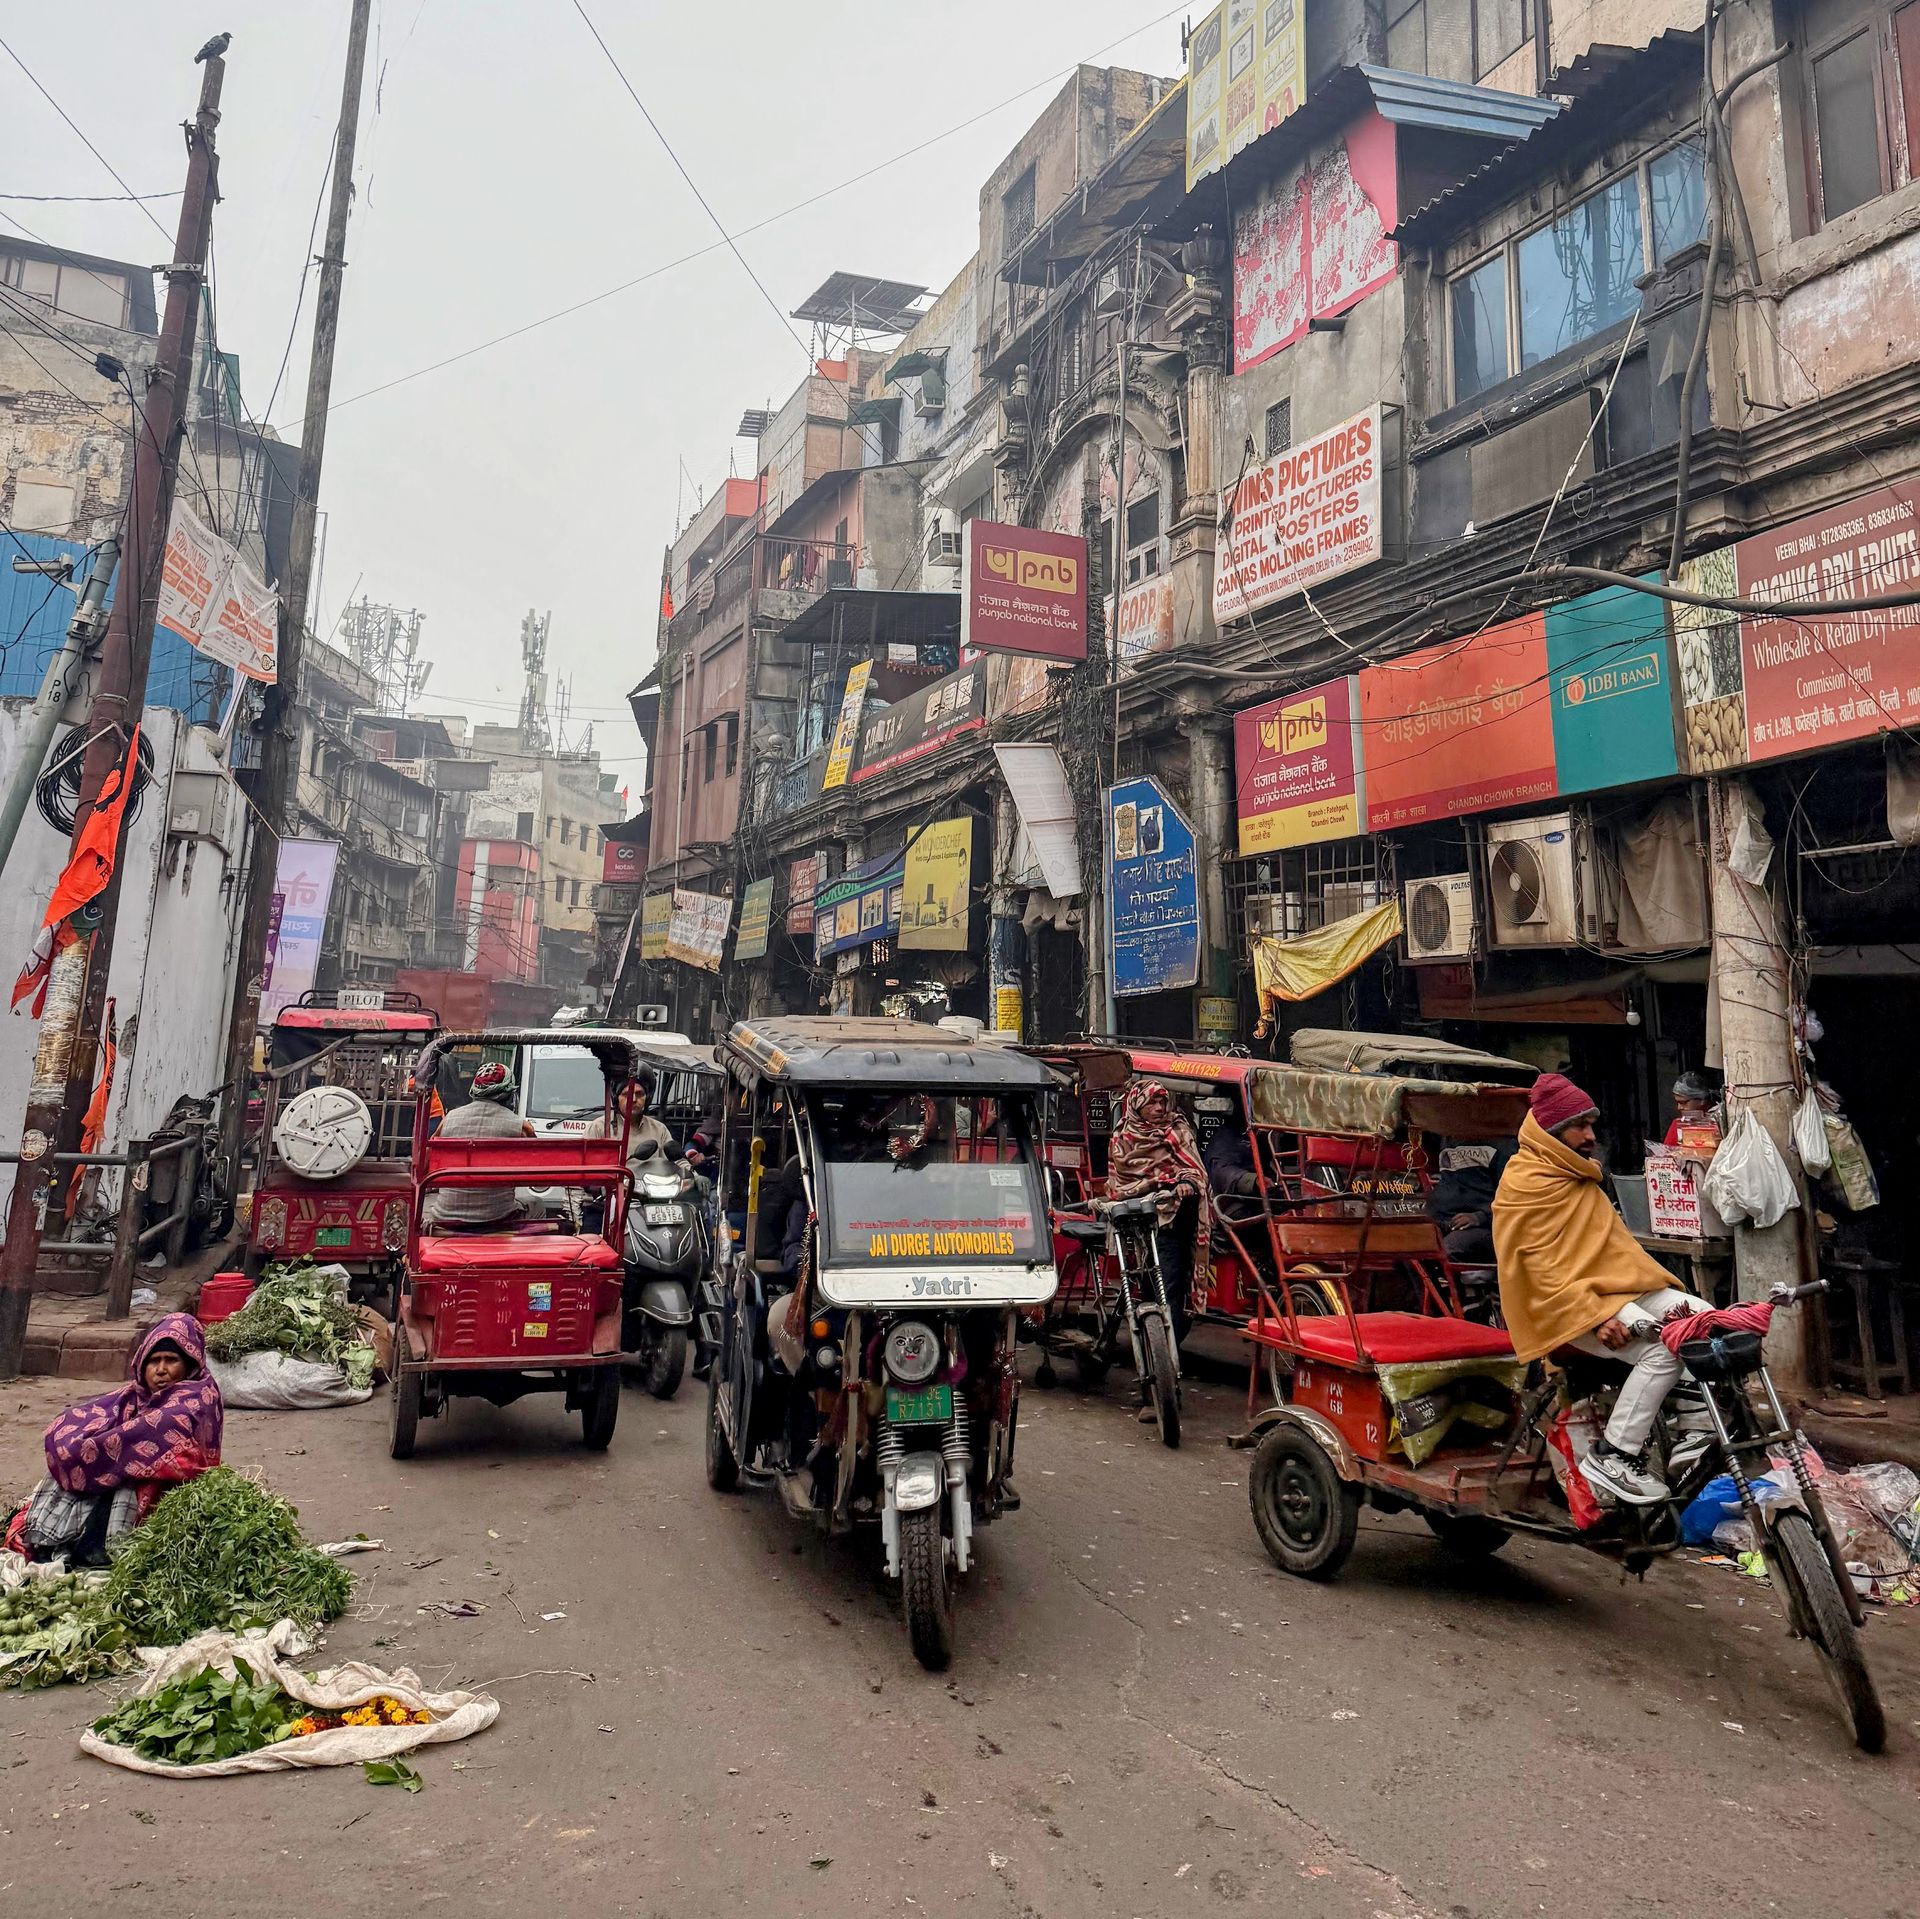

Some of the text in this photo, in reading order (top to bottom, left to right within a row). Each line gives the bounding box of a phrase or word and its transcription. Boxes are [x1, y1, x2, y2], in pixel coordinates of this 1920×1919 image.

[1279, 417, 1372, 496] PICTURES
[1235, 458, 1373, 541] PRINTED PICTURERS
[1222, 491, 1359, 572] DIGITAL POSTERS
[1216, 563, 1257, 597] CANVAS
[1316, 514, 1369, 553] FRAMES
[1775, 542, 1798, 562] VEERU
[1799, 536, 1817, 555] BHAI
[1022, 559, 1073, 584] pnb
[1821, 549, 1856, 601] DRY
[1858, 529, 1920, 597] FRUITS
[978, 607, 1079, 631] punjab national bank
[979, 593, 1070, 617] पंजाब नैशनल बैंक
[1752, 627, 1811, 670] Wholesale
[1813, 625, 1824, 654] &
[1825, 611, 1861, 650] Retail
[1862, 611, 1886, 645] Dry
[51, 679, 62, 691] P
[1587, 664, 1654, 694] IDBI BANK
[1796, 661, 1873, 699] Commission Agent
[47, 691, 62, 703] 18
[1490, 678, 1525, 714] बैंक
[1285, 703, 1324, 750] pnb
[1253, 771, 1278, 788] पंजाब
[1311, 754, 1328, 773] बैंक
[1253, 771, 1337, 809] punjab national bank
[1447, 781, 1552, 810] CHANDNI CHOWK BRANCH
[343, 994, 381, 1006] PILOT
[1170, 1061, 1222, 1077] 9891111252
[562, 1121, 587, 1131] WARD
[869, 1232, 1015, 1257] JAI DURGE AUTOMOBILES
[911, 1276, 972, 1296] Yatri
[1365, 1422, 1378, 1443] 12
